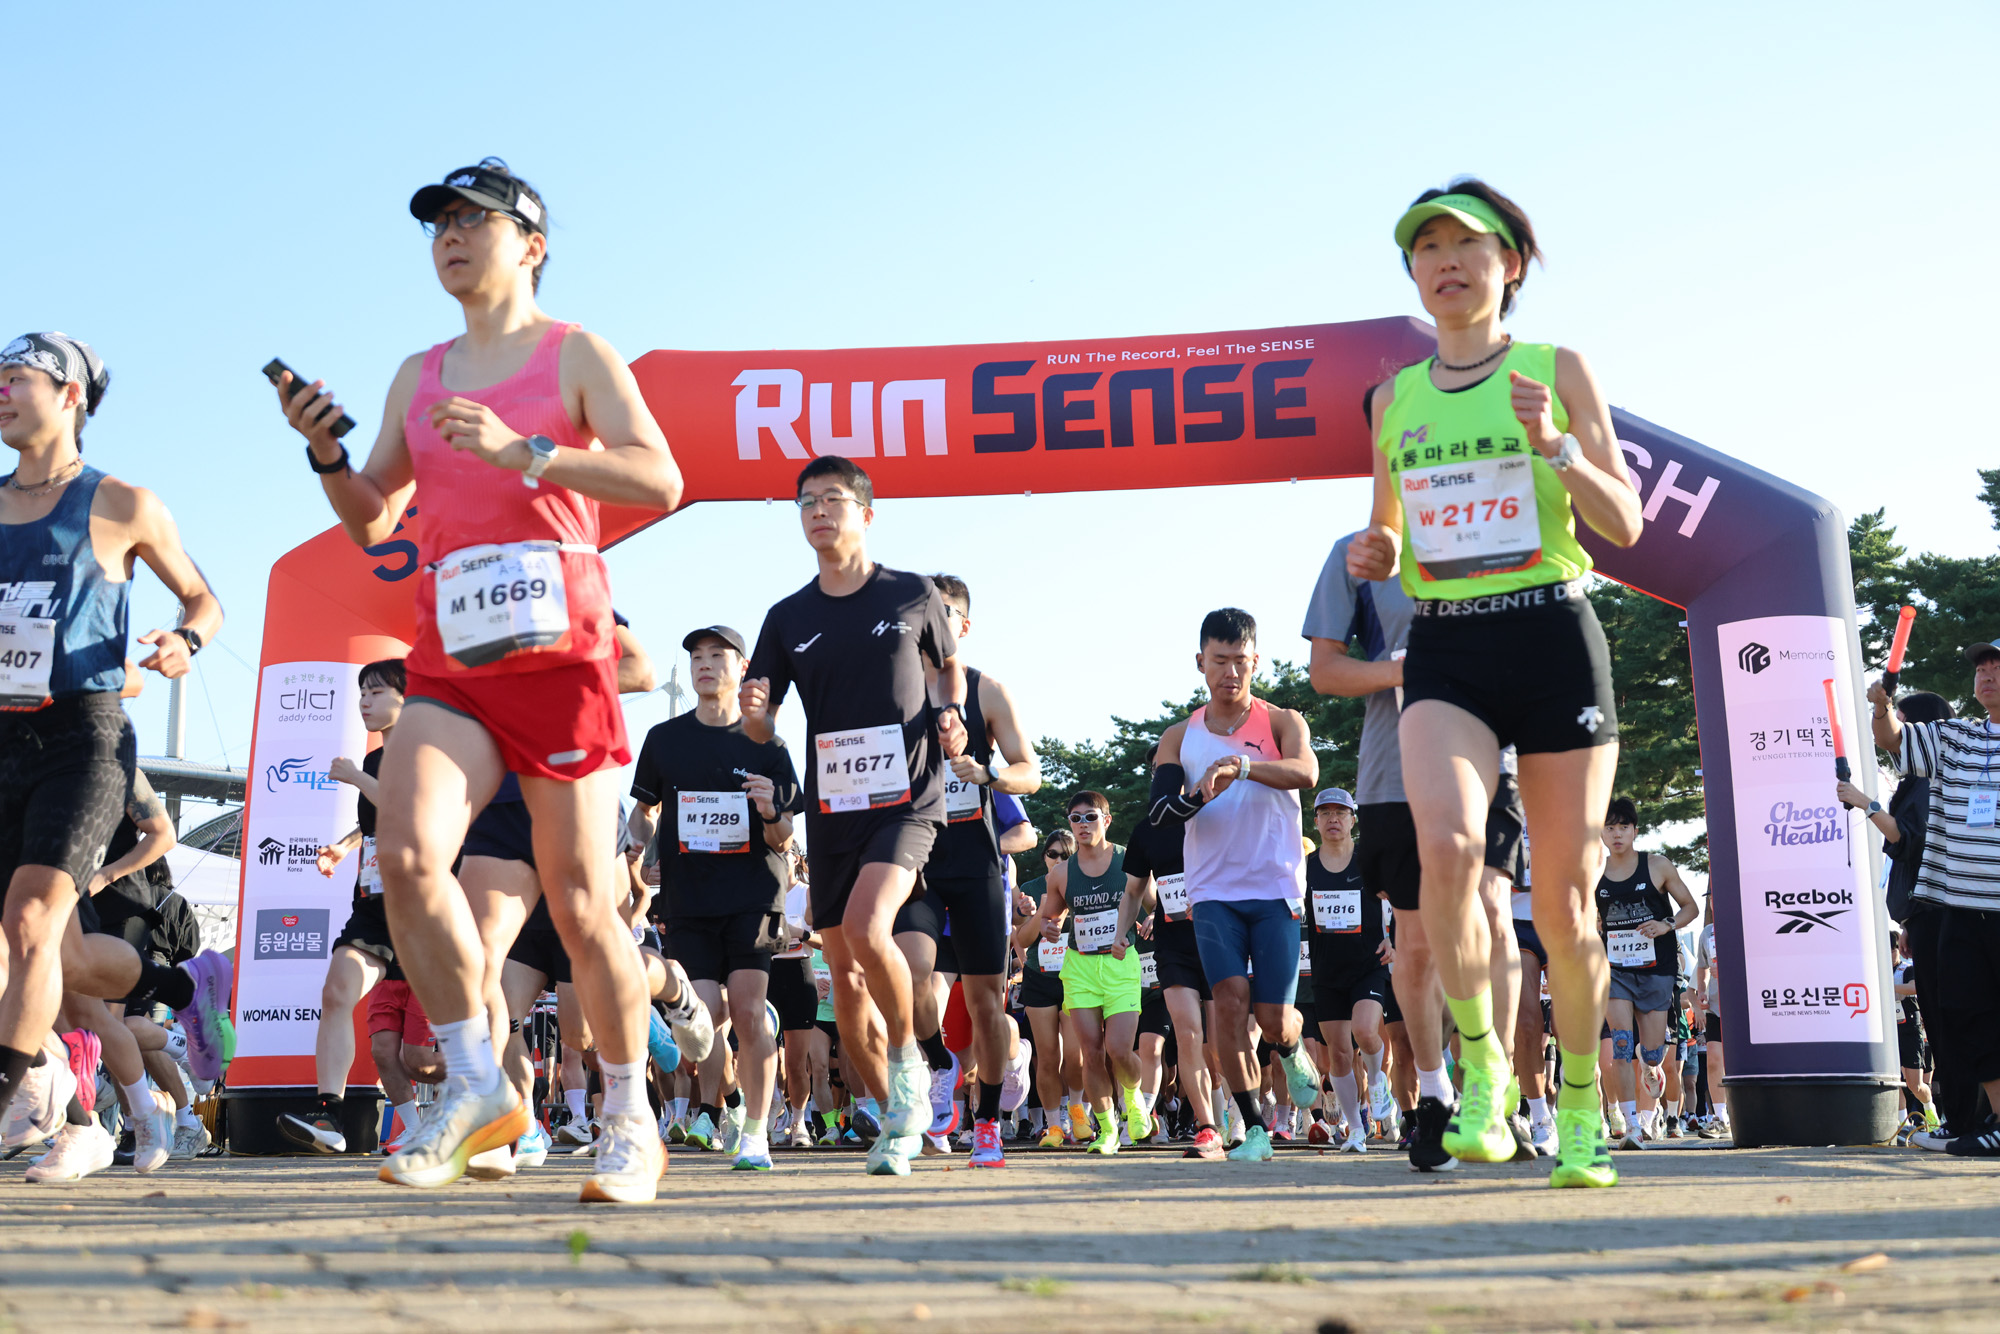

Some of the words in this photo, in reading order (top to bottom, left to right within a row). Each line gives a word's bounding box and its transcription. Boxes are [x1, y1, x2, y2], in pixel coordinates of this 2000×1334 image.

[1047, 353, 1081, 365] RUN
[1085, 352, 1116, 363] The
[1121, 348, 1181, 361] Record,
[1187, 345, 1220, 357] Feel
[1225, 343, 1256, 354] The
[1260, 338, 1315, 352] SENSE
[730, 367, 948, 460] Run
[1404, 475, 1430, 492] Run
[1419, 510, 1436, 527] W
[1442, 496, 1519, 527] 2176
[451, 596, 466, 615] M
[473, 578, 547, 611] 1669
[1437, 588, 1546, 617] DESCENTE
[1779, 650, 1836, 661] MemorinG
[278, 713, 307, 723] daddy
[308, 712, 333, 722] food
[818, 739, 834, 749] Run
[826, 762, 838, 774] M
[843, 753, 895, 774] 1677
[681, 795, 697, 804] Run
[838, 796, 862, 806] A-90
[1769, 801, 1837, 824] Choco
[1972, 807, 1992, 815] STAFF
[686, 813, 698, 823] M
[700, 812, 740, 826] 1289
[1763, 819, 1844, 847] Health
[288, 844, 322, 857] Habi
[287, 857, 299, 865] for
[1073, 893, 1110, 907] BEYOND
[1165, 892, 1171, 900] M
[1764, 888, 1854, 909] Reebok
[1326, 905, 1355, 914] 1816
[1617, 918, 1643, 926] MARATHON
[1079, 929, 1086, 937] M
[1088, 924, 1116, 937] 1625
[258, 931, 323, 954] 동원샘물
[1621, 942, 1649, 953] 1123
[1761, 986, 1842, 1009] 일요신문
[242, 1008, 291, 1022] WOMAN
[294, 1008, 323, 1021] SEN
